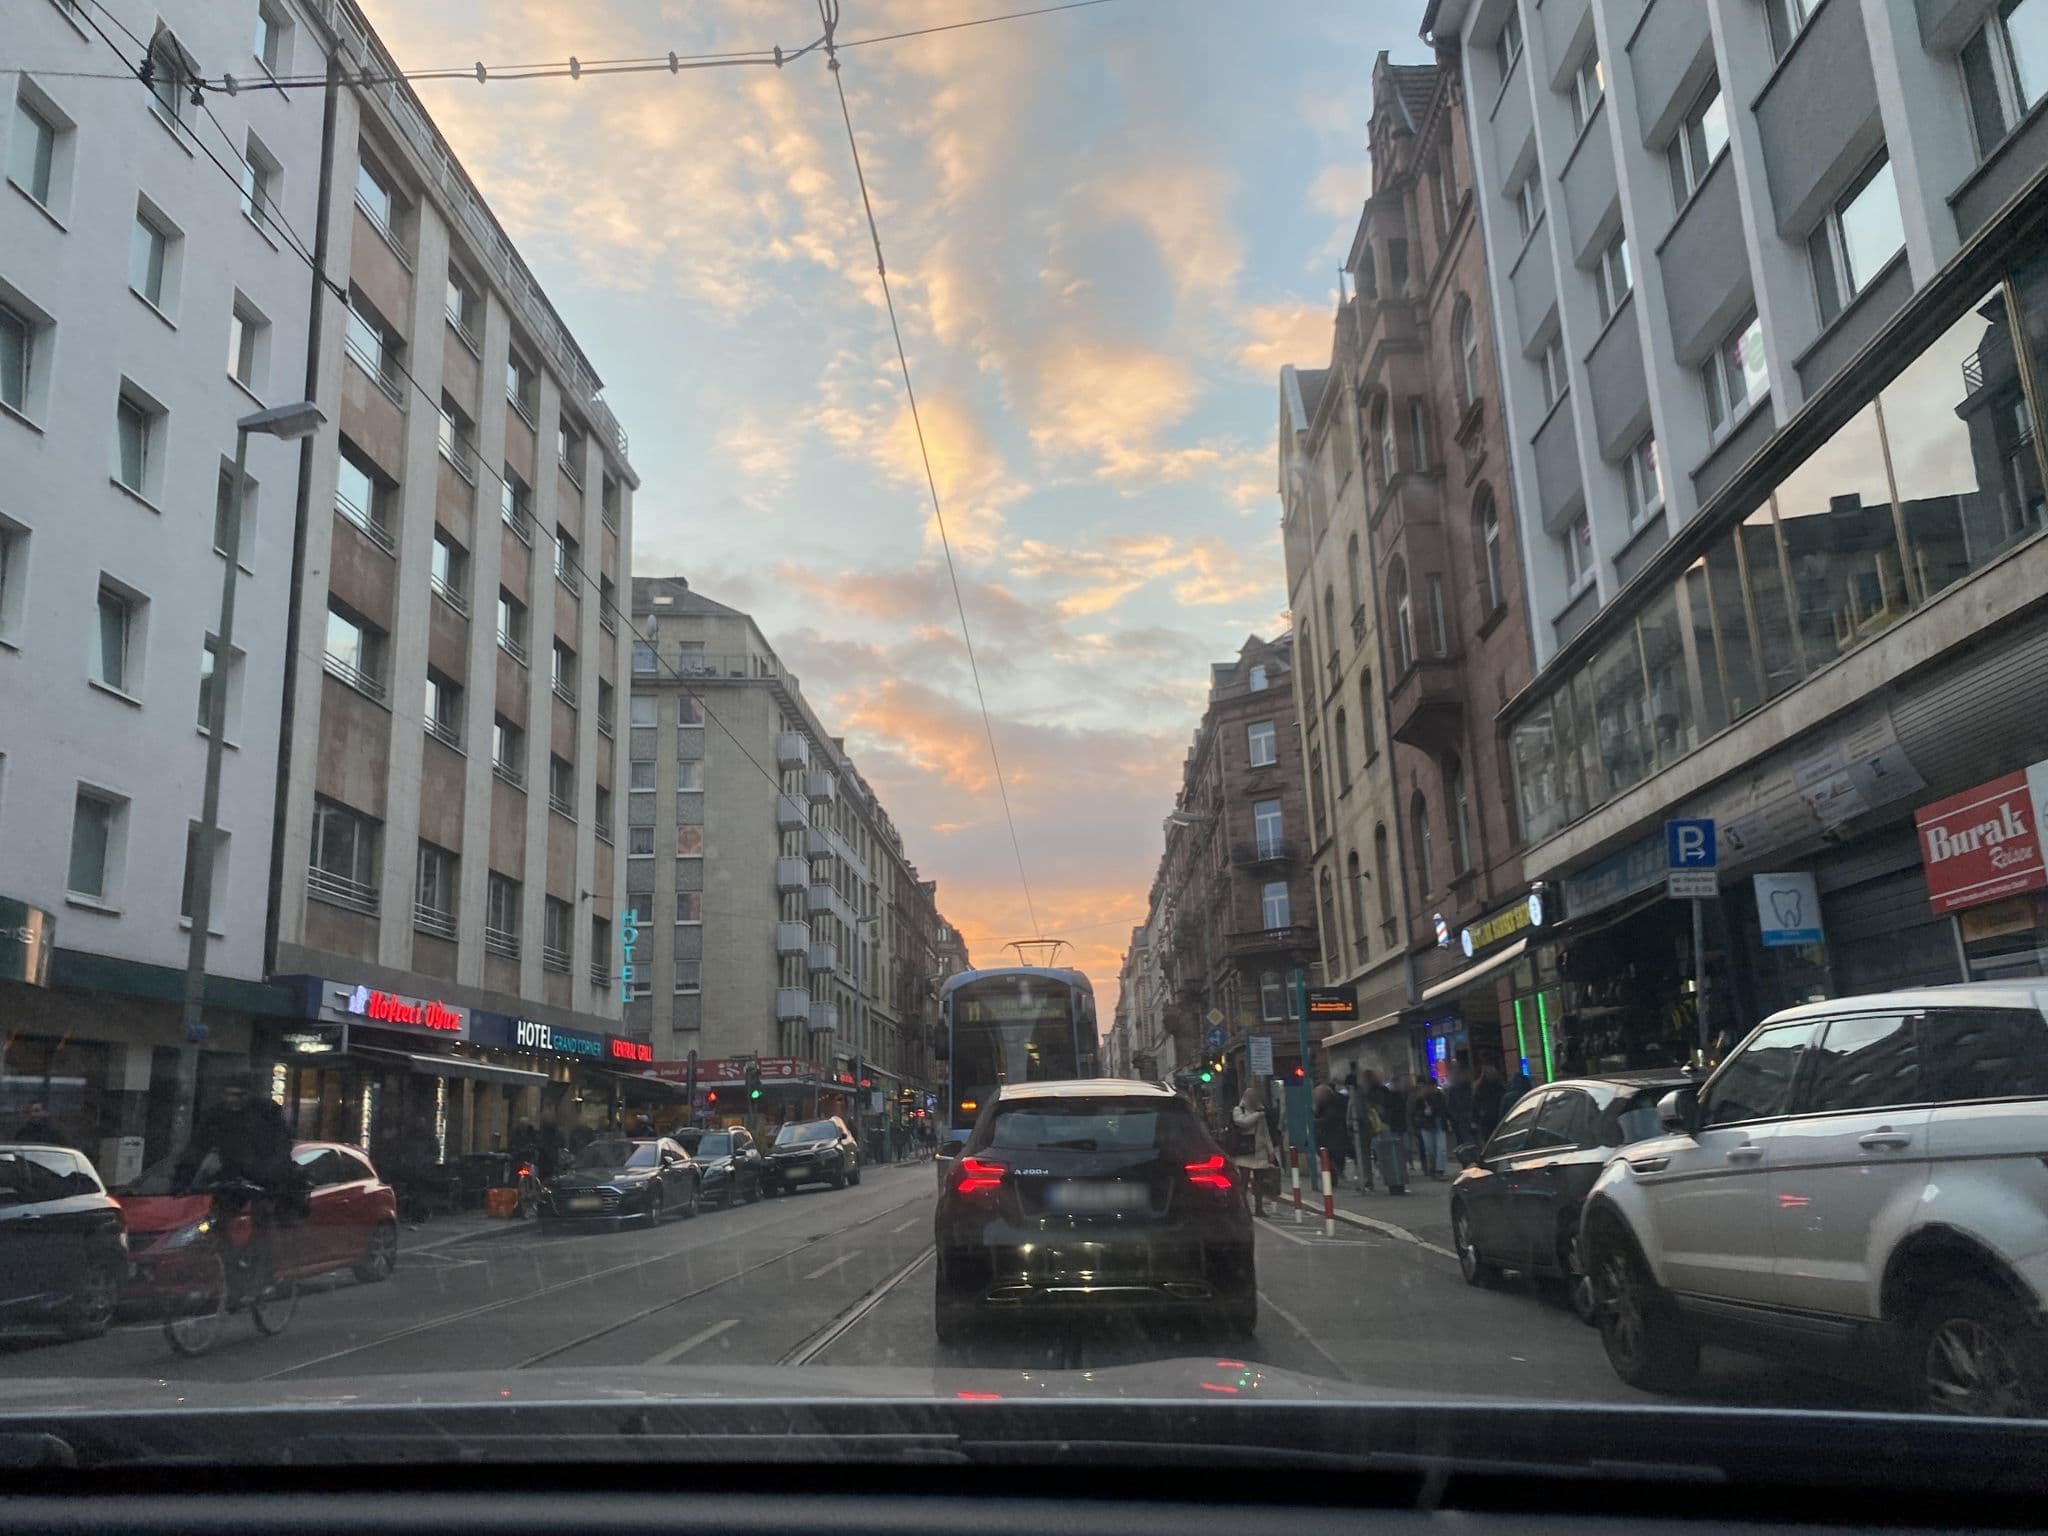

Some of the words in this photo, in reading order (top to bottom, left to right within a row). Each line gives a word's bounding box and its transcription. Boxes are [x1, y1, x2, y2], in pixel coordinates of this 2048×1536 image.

[1678, 826, 1705, 863] P
[1926, 803, 2027, 863] Burak
[621, 908, 638, 1002] HOTEL
[517, 1020, 553, 1050] HOTEL
[554, 1034, 577, 1054] GRAND
[612, 1039, 637, 1060] CENTRAL
[637, 1044, 653, 1062] GRILL
